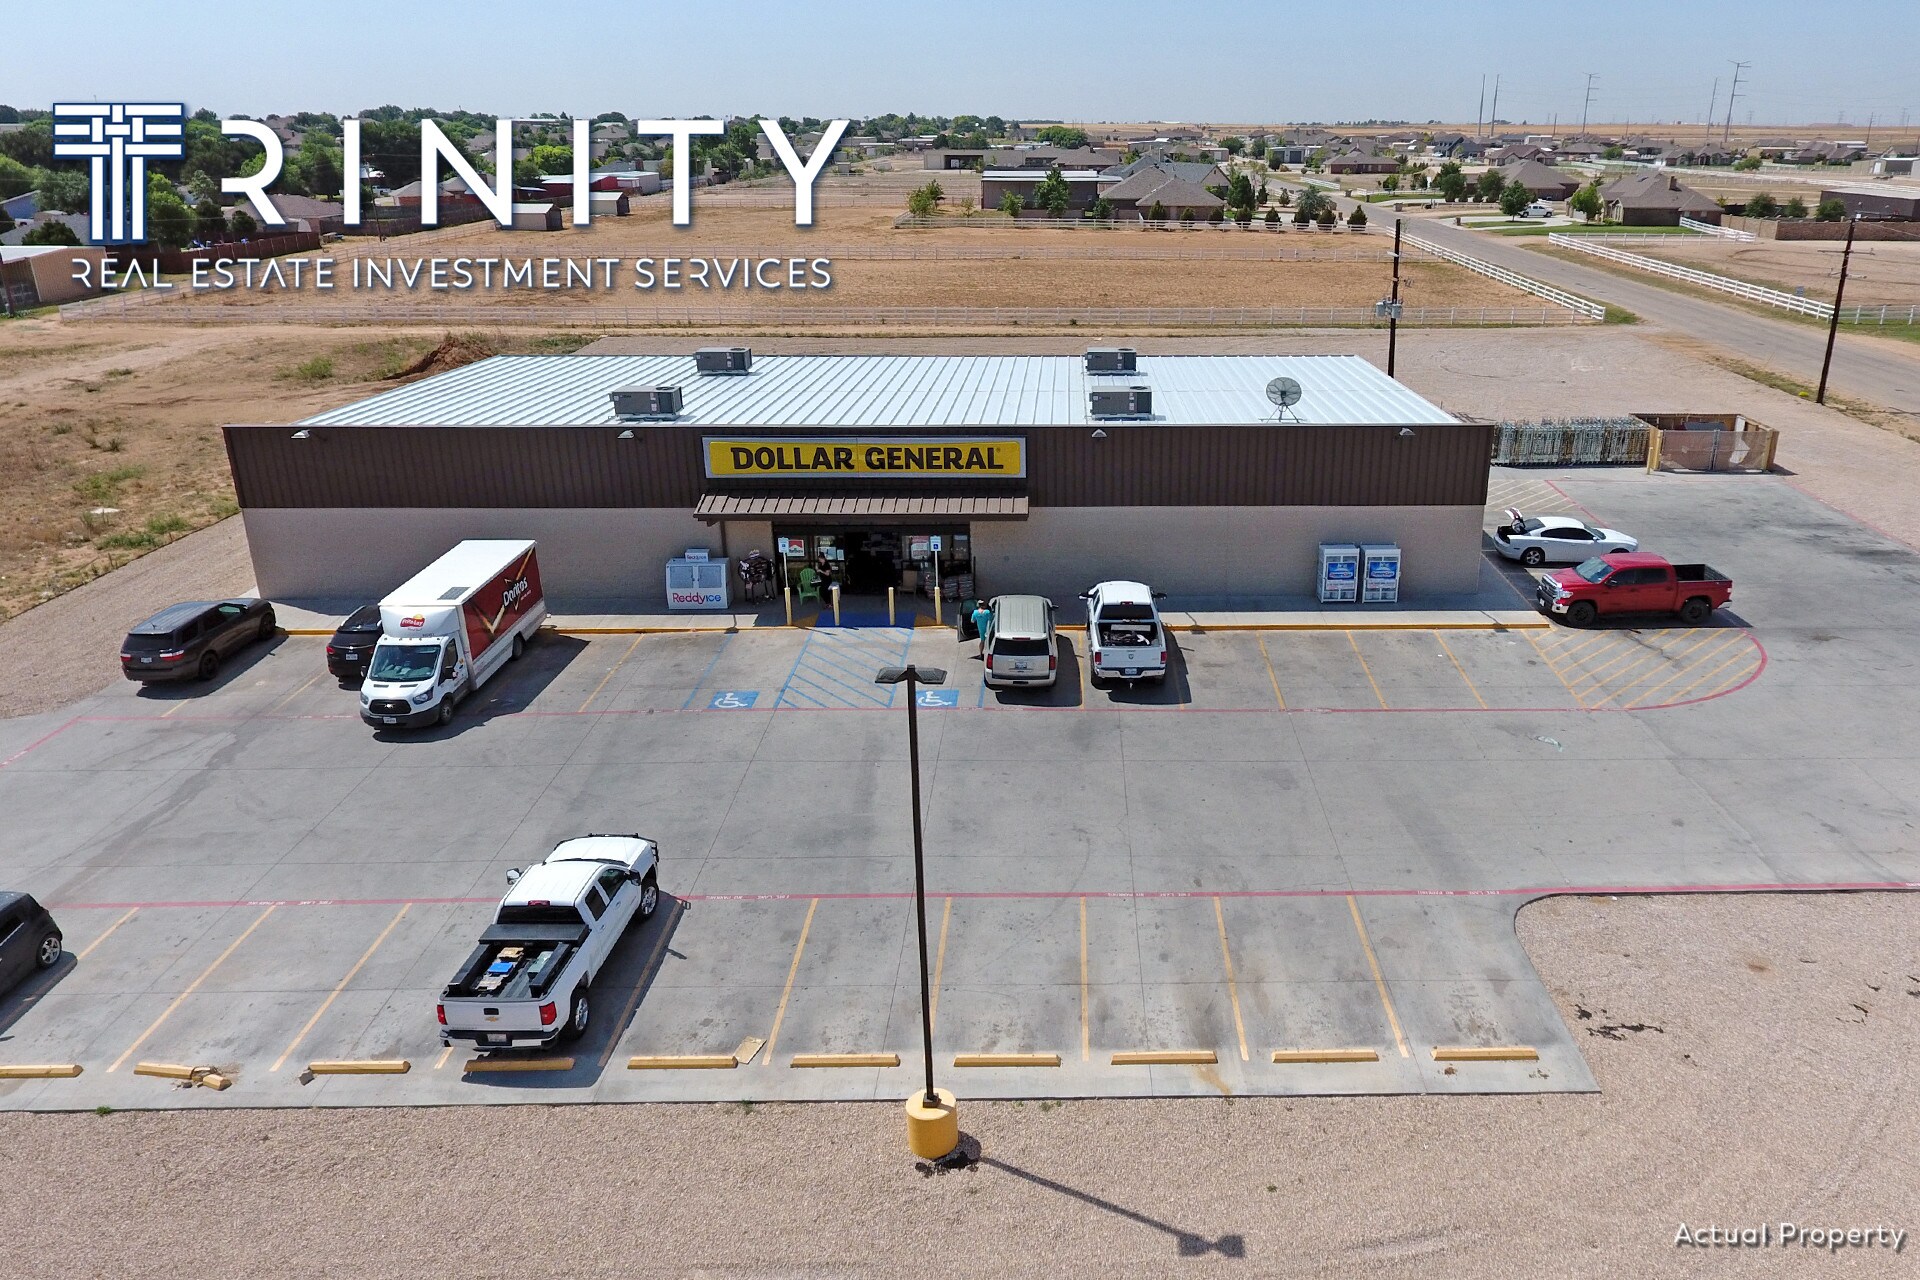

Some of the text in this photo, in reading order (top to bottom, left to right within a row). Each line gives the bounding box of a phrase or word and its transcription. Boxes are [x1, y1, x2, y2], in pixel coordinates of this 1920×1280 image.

[730, 447, 1004, 471] DOLLAR GENERAL
[503, 576, 528, 607] Doritos
